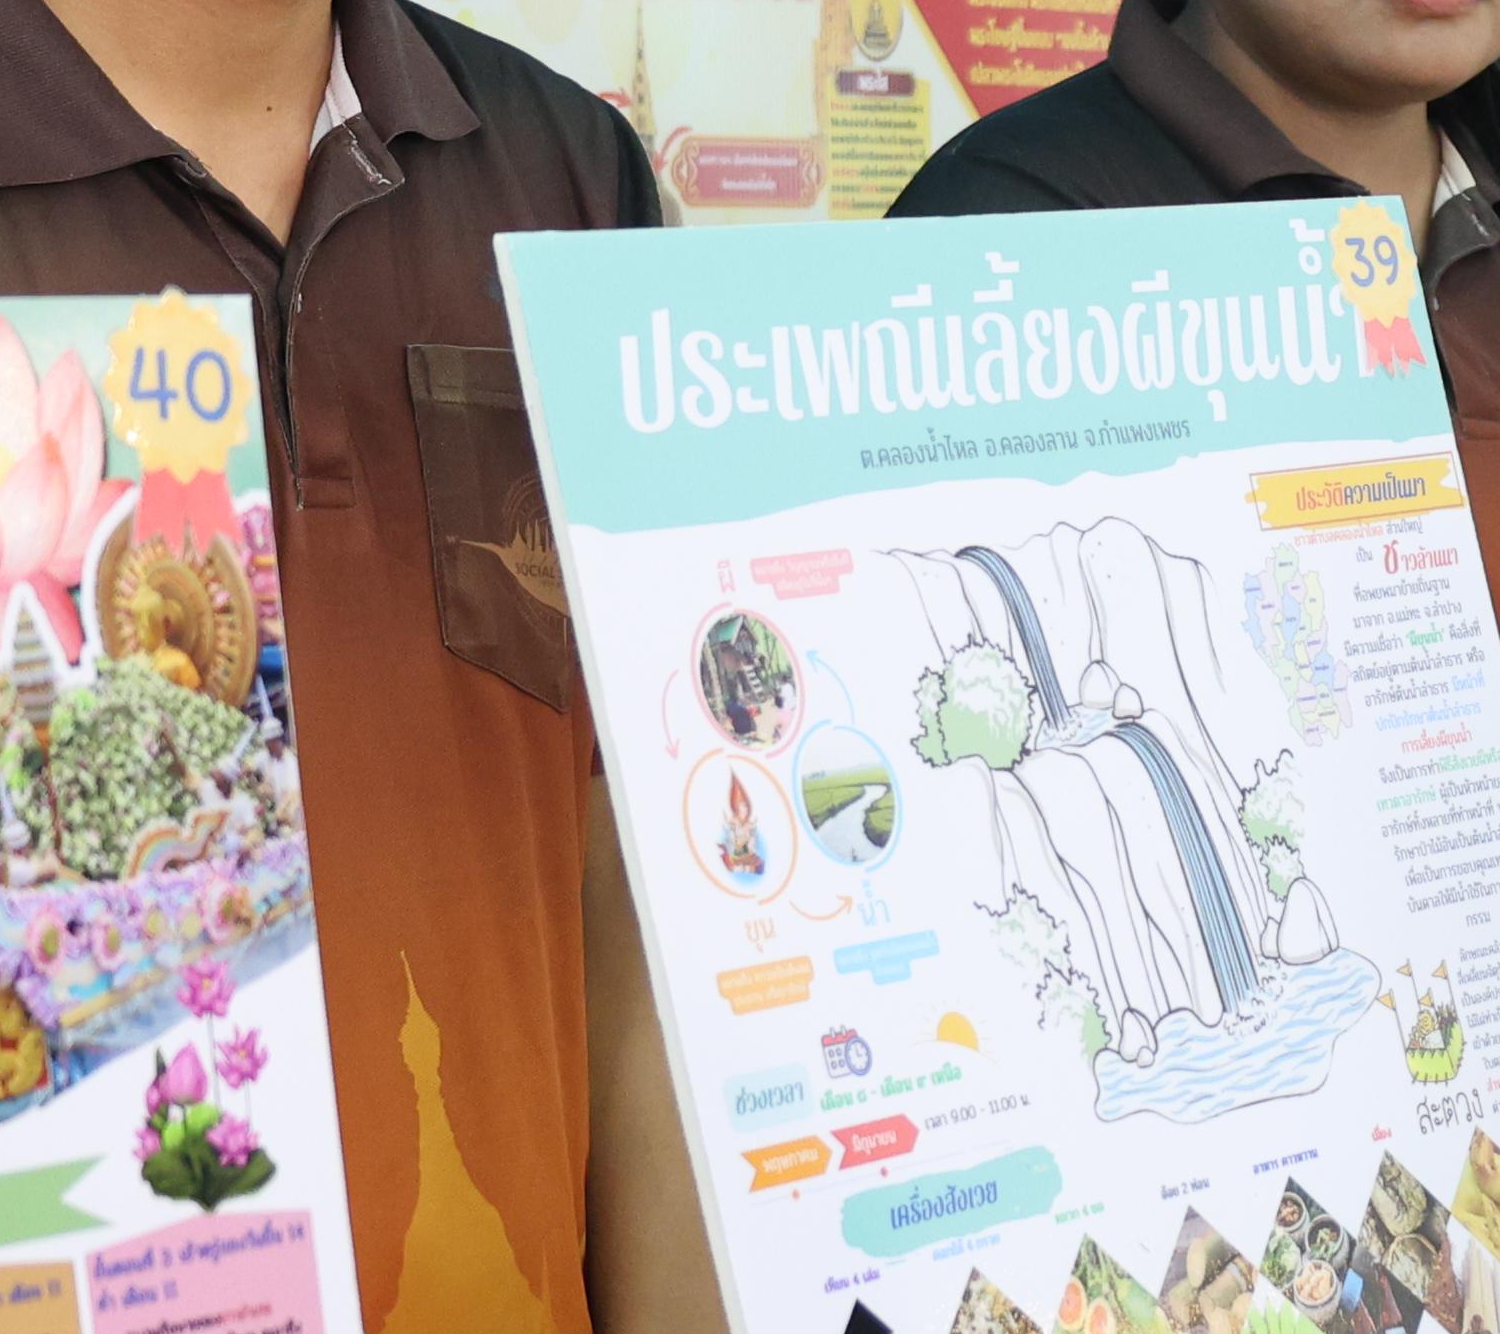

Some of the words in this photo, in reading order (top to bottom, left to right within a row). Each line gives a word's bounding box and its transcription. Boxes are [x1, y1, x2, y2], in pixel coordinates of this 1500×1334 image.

[1345, 233, 1400, 289] 39
[126, 334, 233, 423] 40
[1295, 474, 1427, 512] ประวัติความเป็นมา
[735, 1082, 805, 1116] ช่วงเวลา
[889, 1179, 998, 1230] เครื่องสังเวย
